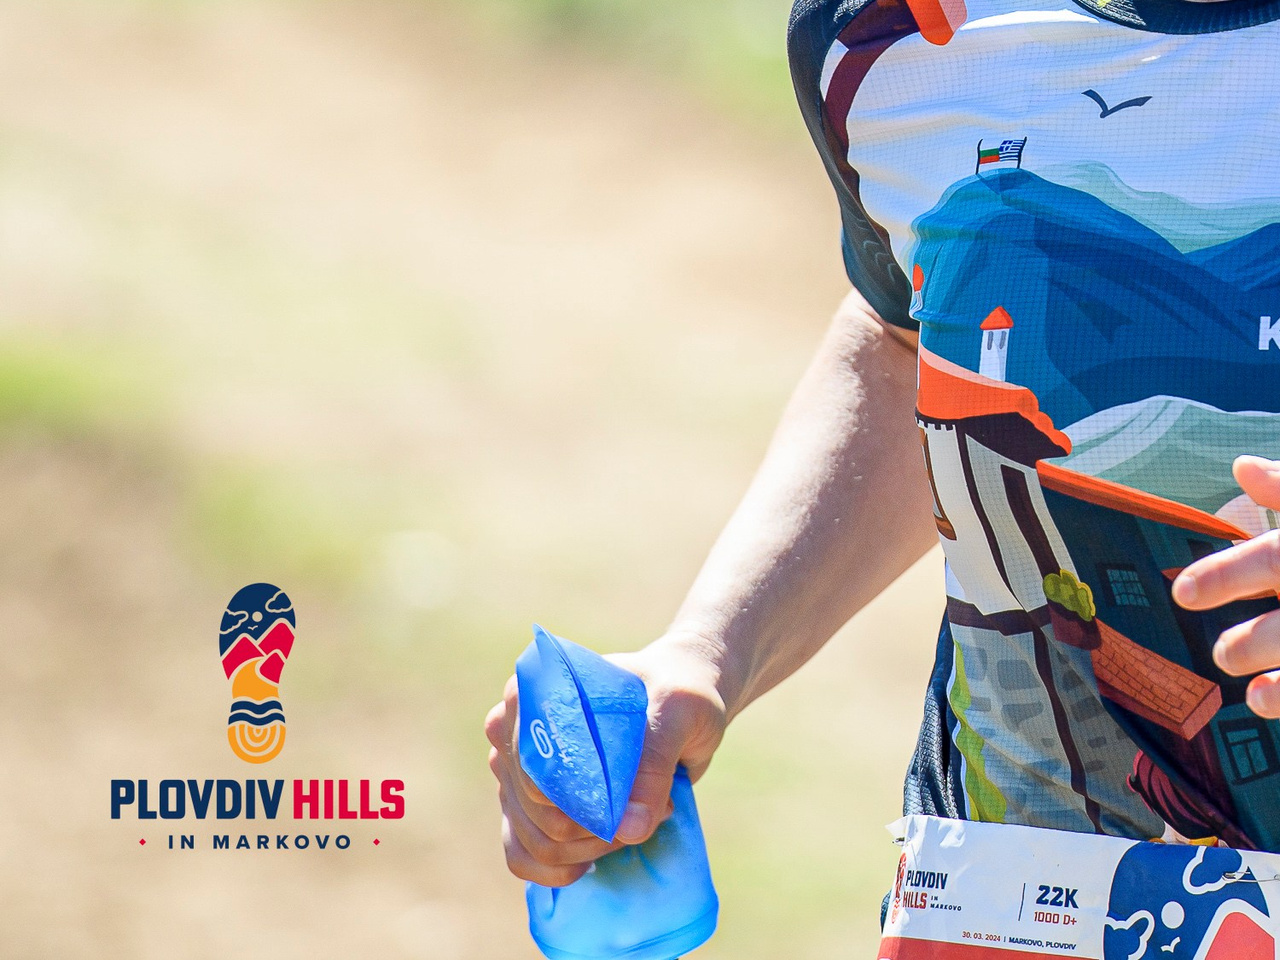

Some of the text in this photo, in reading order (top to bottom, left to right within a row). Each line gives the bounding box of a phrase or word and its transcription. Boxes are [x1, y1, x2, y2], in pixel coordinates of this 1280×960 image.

[905, 869, 949, 890] PLOVDIV
[902, 890, 928, 910] HILLS
[1035, 884, 1079, 909] 22K
[929, 903, 963, 912] MARKOVO
[1033, 910, 1077, 926] 1000 D+
[985, 933, 1001, 942] 2024
[1008, 936, 1045, 948] MARKOVO,
[1045, 940, 1077, 950] PLOVDIV
